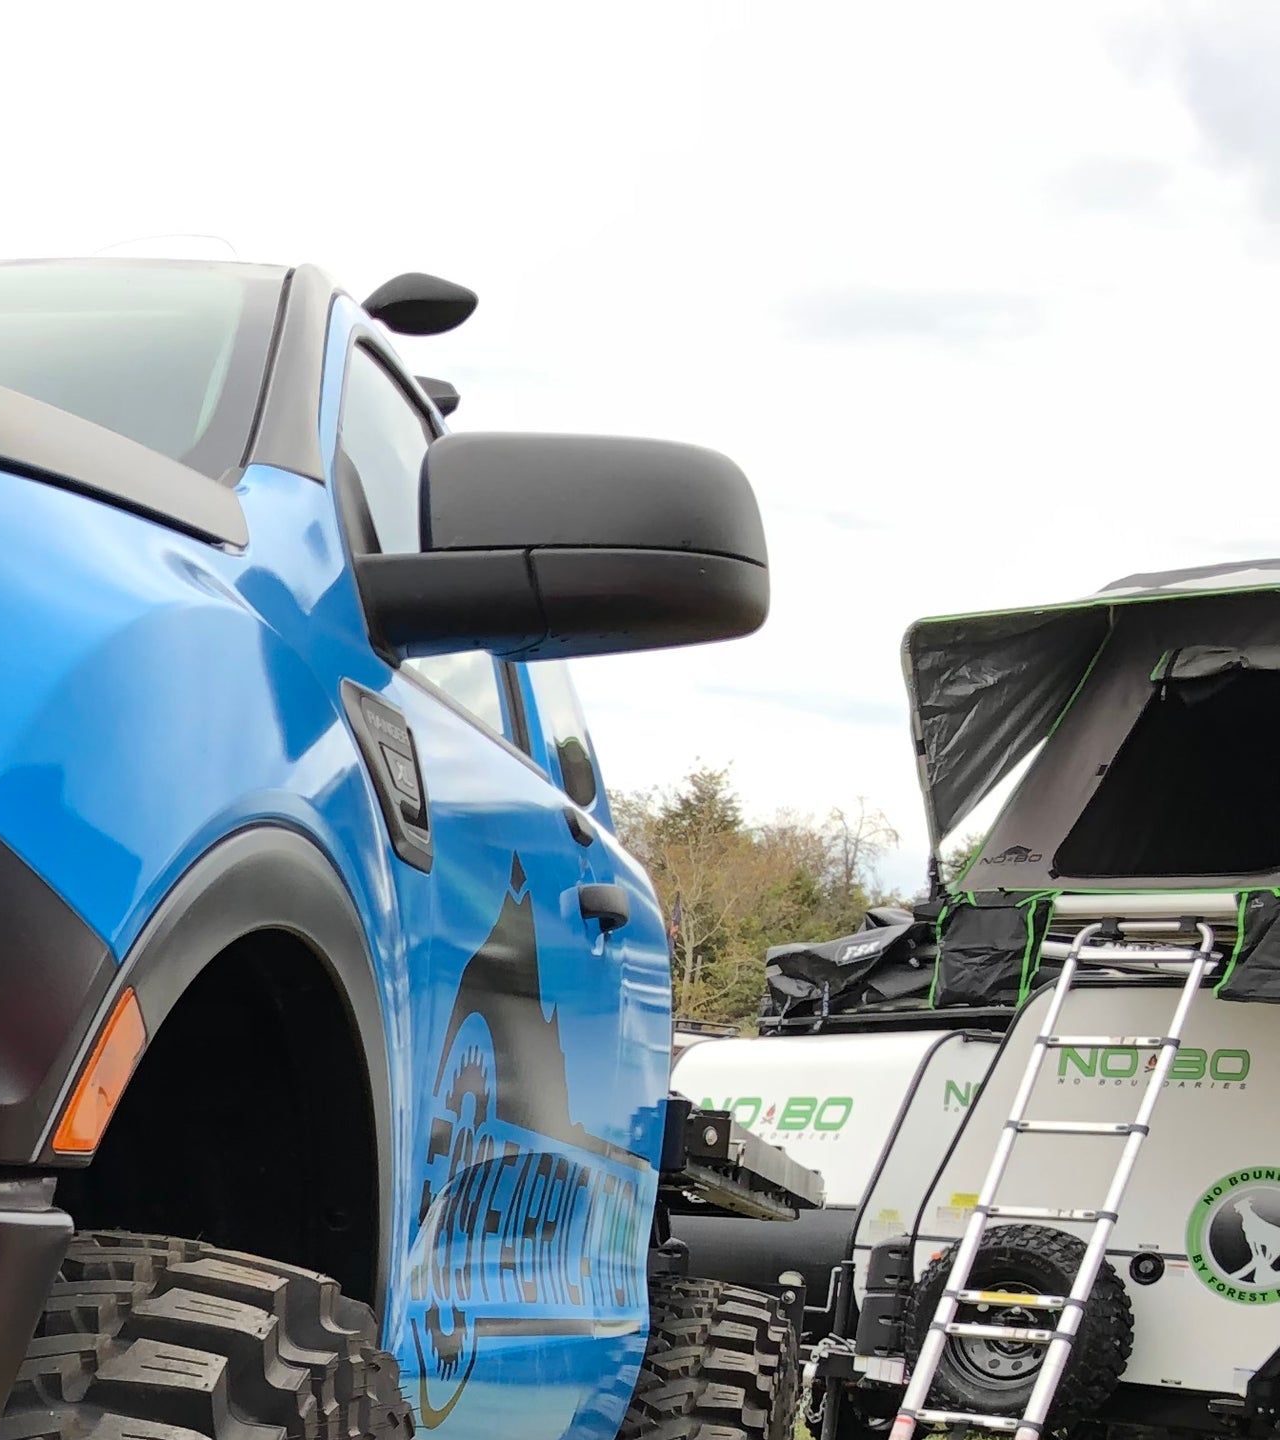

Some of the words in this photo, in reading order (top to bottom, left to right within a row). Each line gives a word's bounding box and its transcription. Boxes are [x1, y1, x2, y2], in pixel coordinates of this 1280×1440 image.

[943, 1079, 983, 1107] N
[1099, 1080, 1246, 1090] BOUDARIES
[777, 1097, 853, 1131] BO
[1203, 1186, 1223, 1205] NO
[1228, 1170, 1280, 1187] BOUN
[1192, 1254, 1208, 1272] BY
[1208, 1276, 1268, 1302] FOREST
